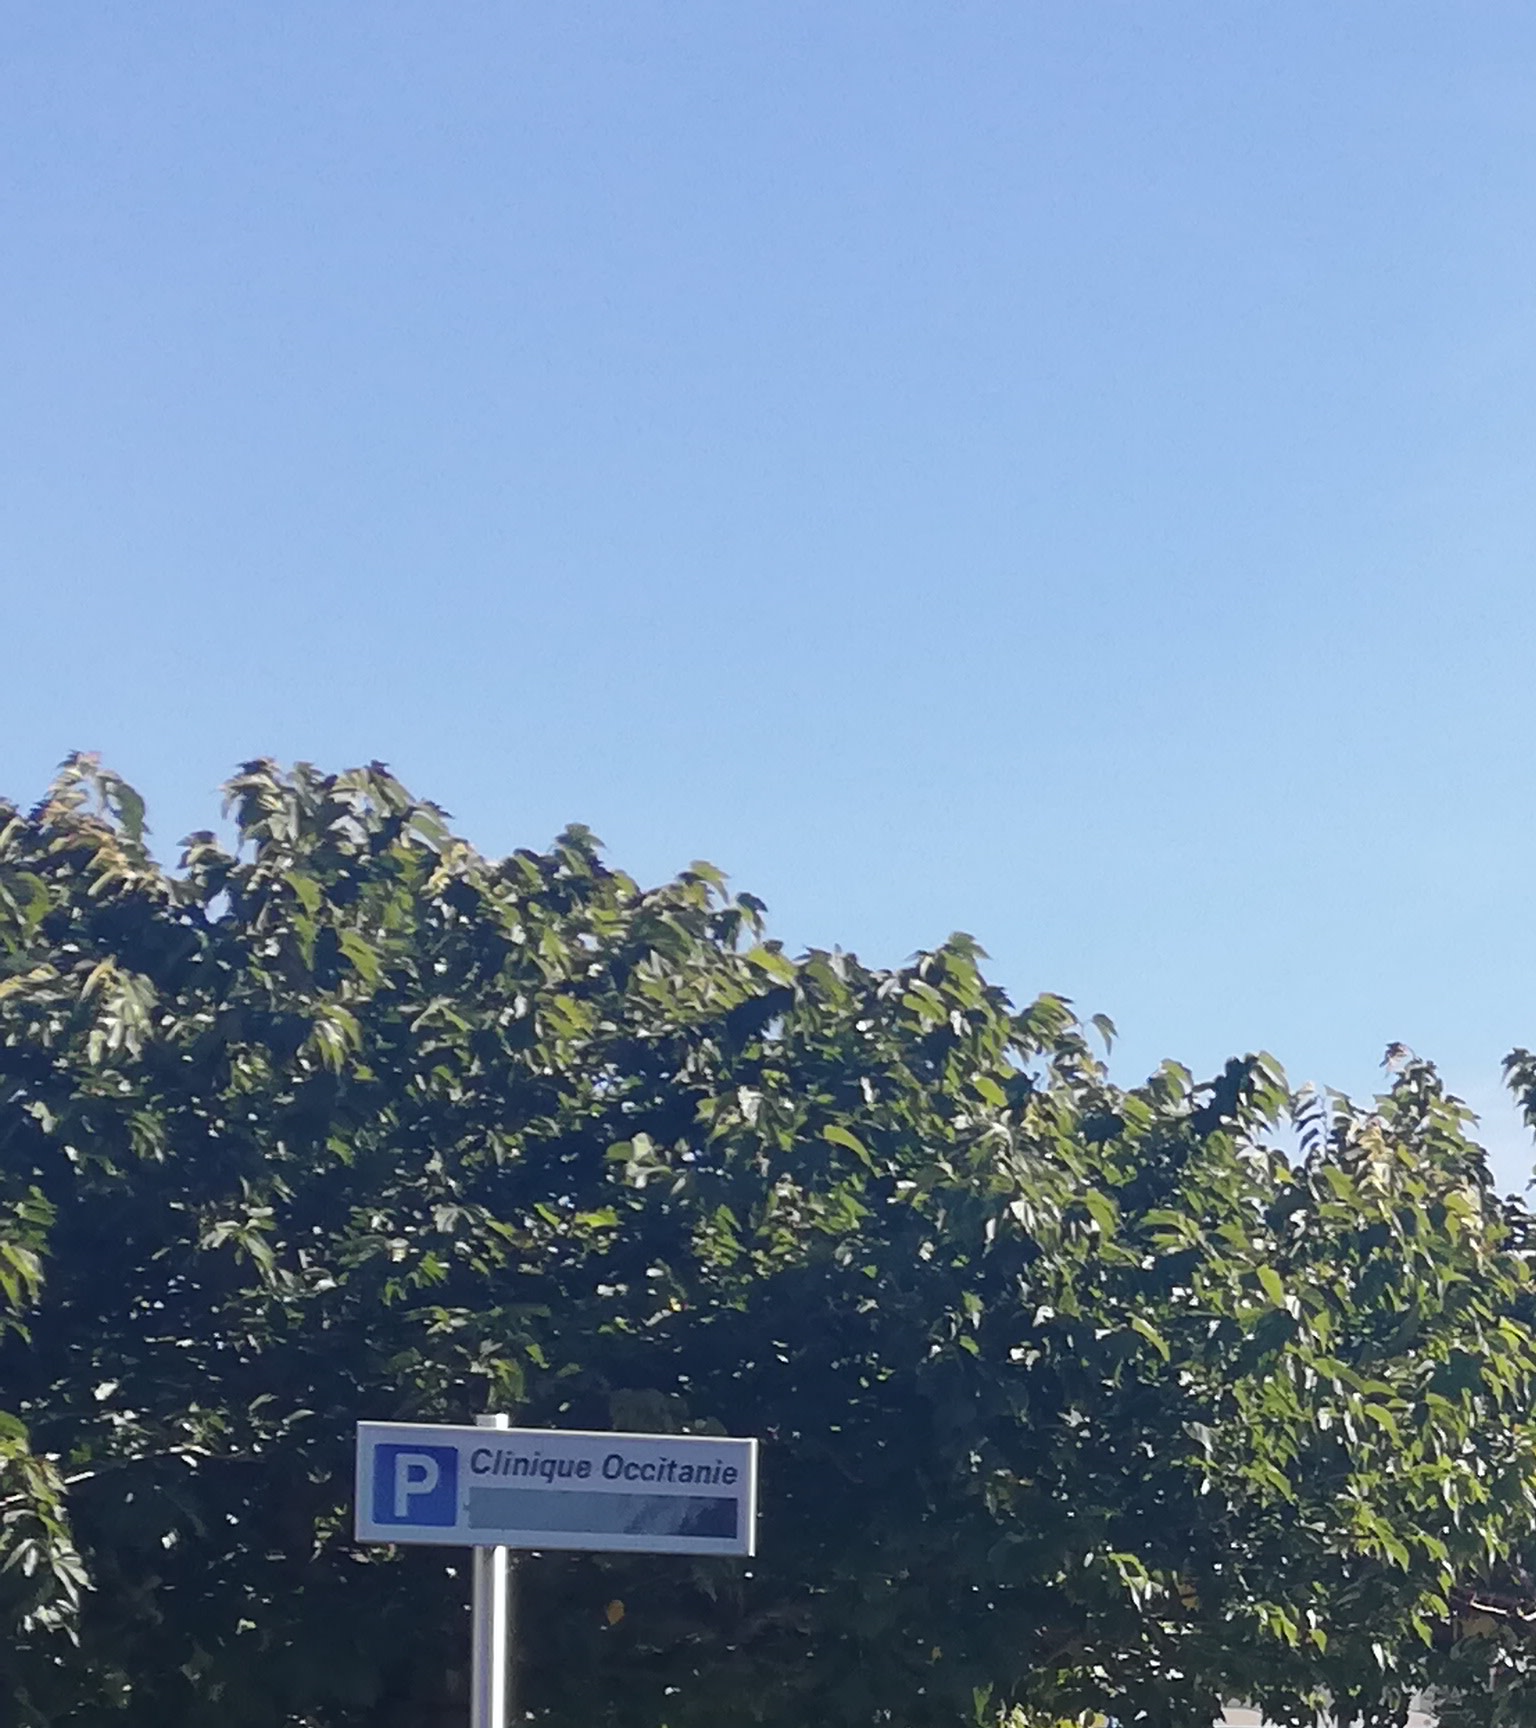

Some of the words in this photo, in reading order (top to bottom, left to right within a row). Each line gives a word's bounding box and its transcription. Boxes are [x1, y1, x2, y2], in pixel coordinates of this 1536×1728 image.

[393, 1452, 439, 1518] P
[469, 1448, 592, 1485] Clinique
[601, 1453, 738, 1485] Occitanie
